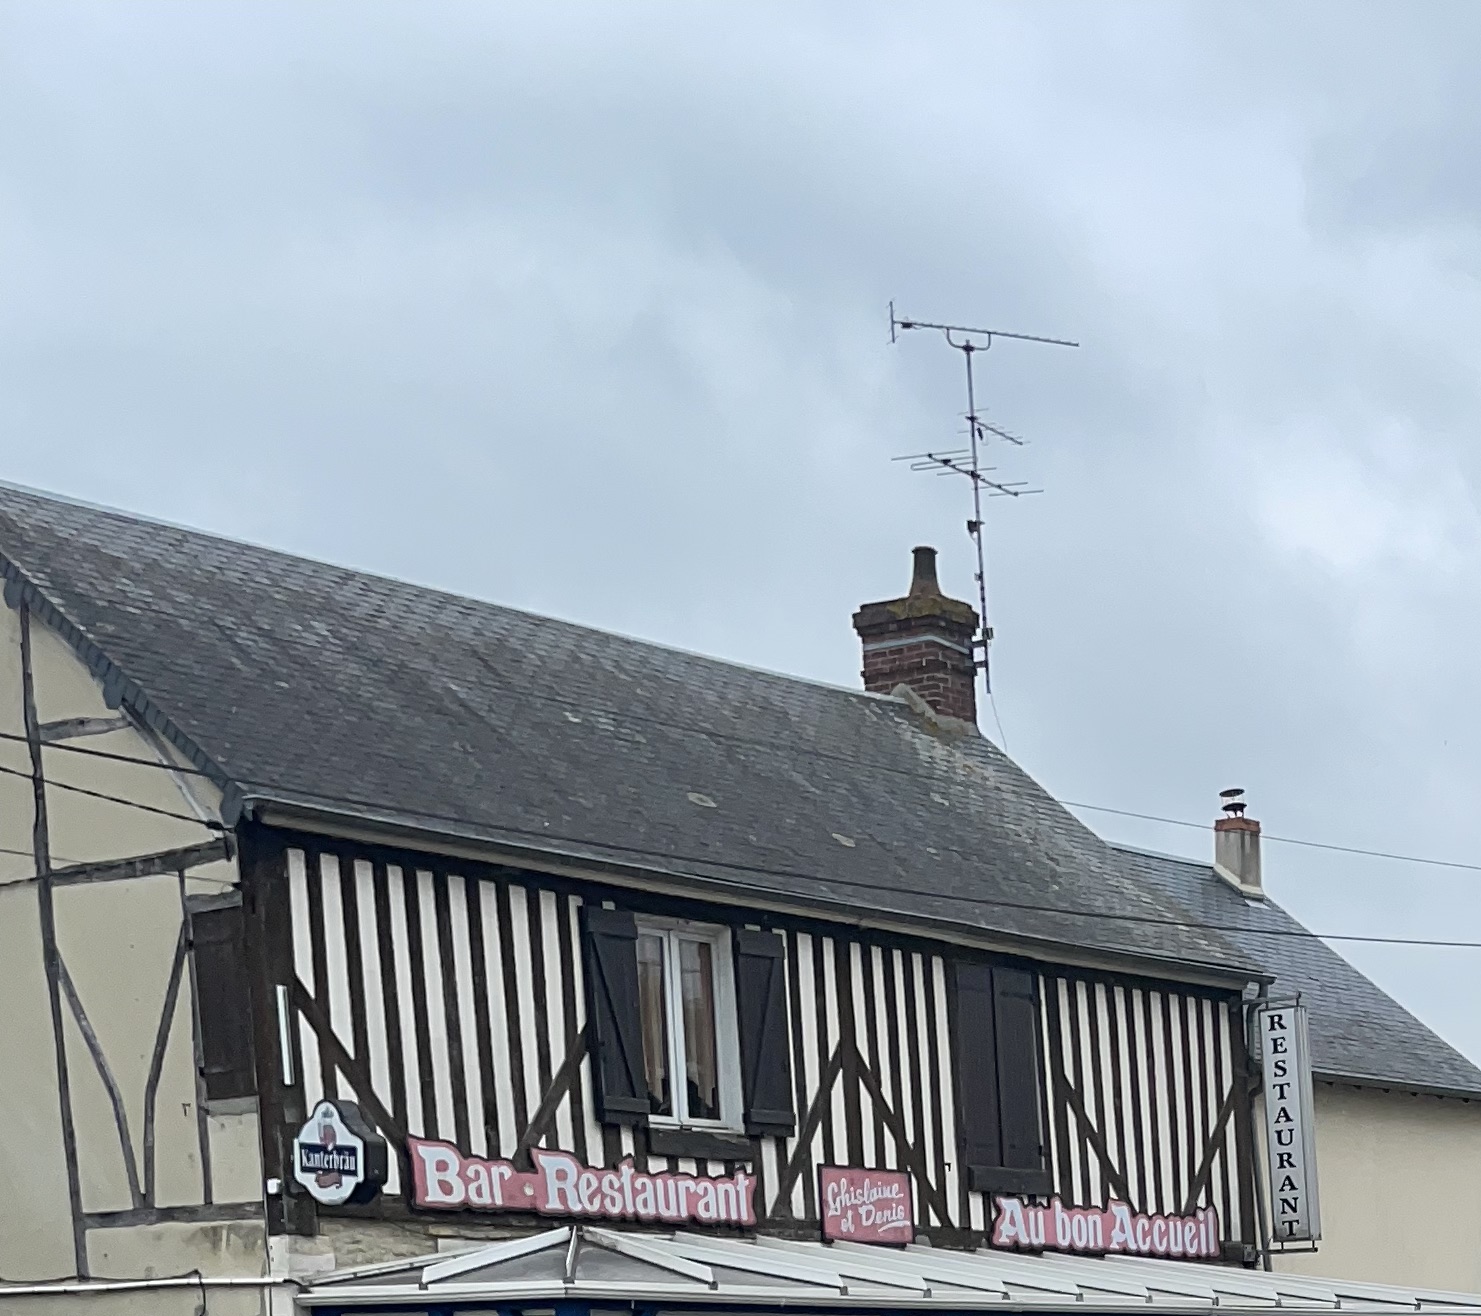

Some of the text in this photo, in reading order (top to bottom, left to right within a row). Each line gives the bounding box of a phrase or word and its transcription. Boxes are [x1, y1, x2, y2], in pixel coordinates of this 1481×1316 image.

[1267, 1013, 1300, 1237] RESTAURANT
[301, 1149, 356, 1171] Kanterbräu
[416, 1145, 750, 1222] Bar Restaurant
[827, 1177, 905, 1218] Ghislaine
[840, 1204, 905, 1234] et Denis
[999, 1198, 1215, 1256] Au bon Accueil
